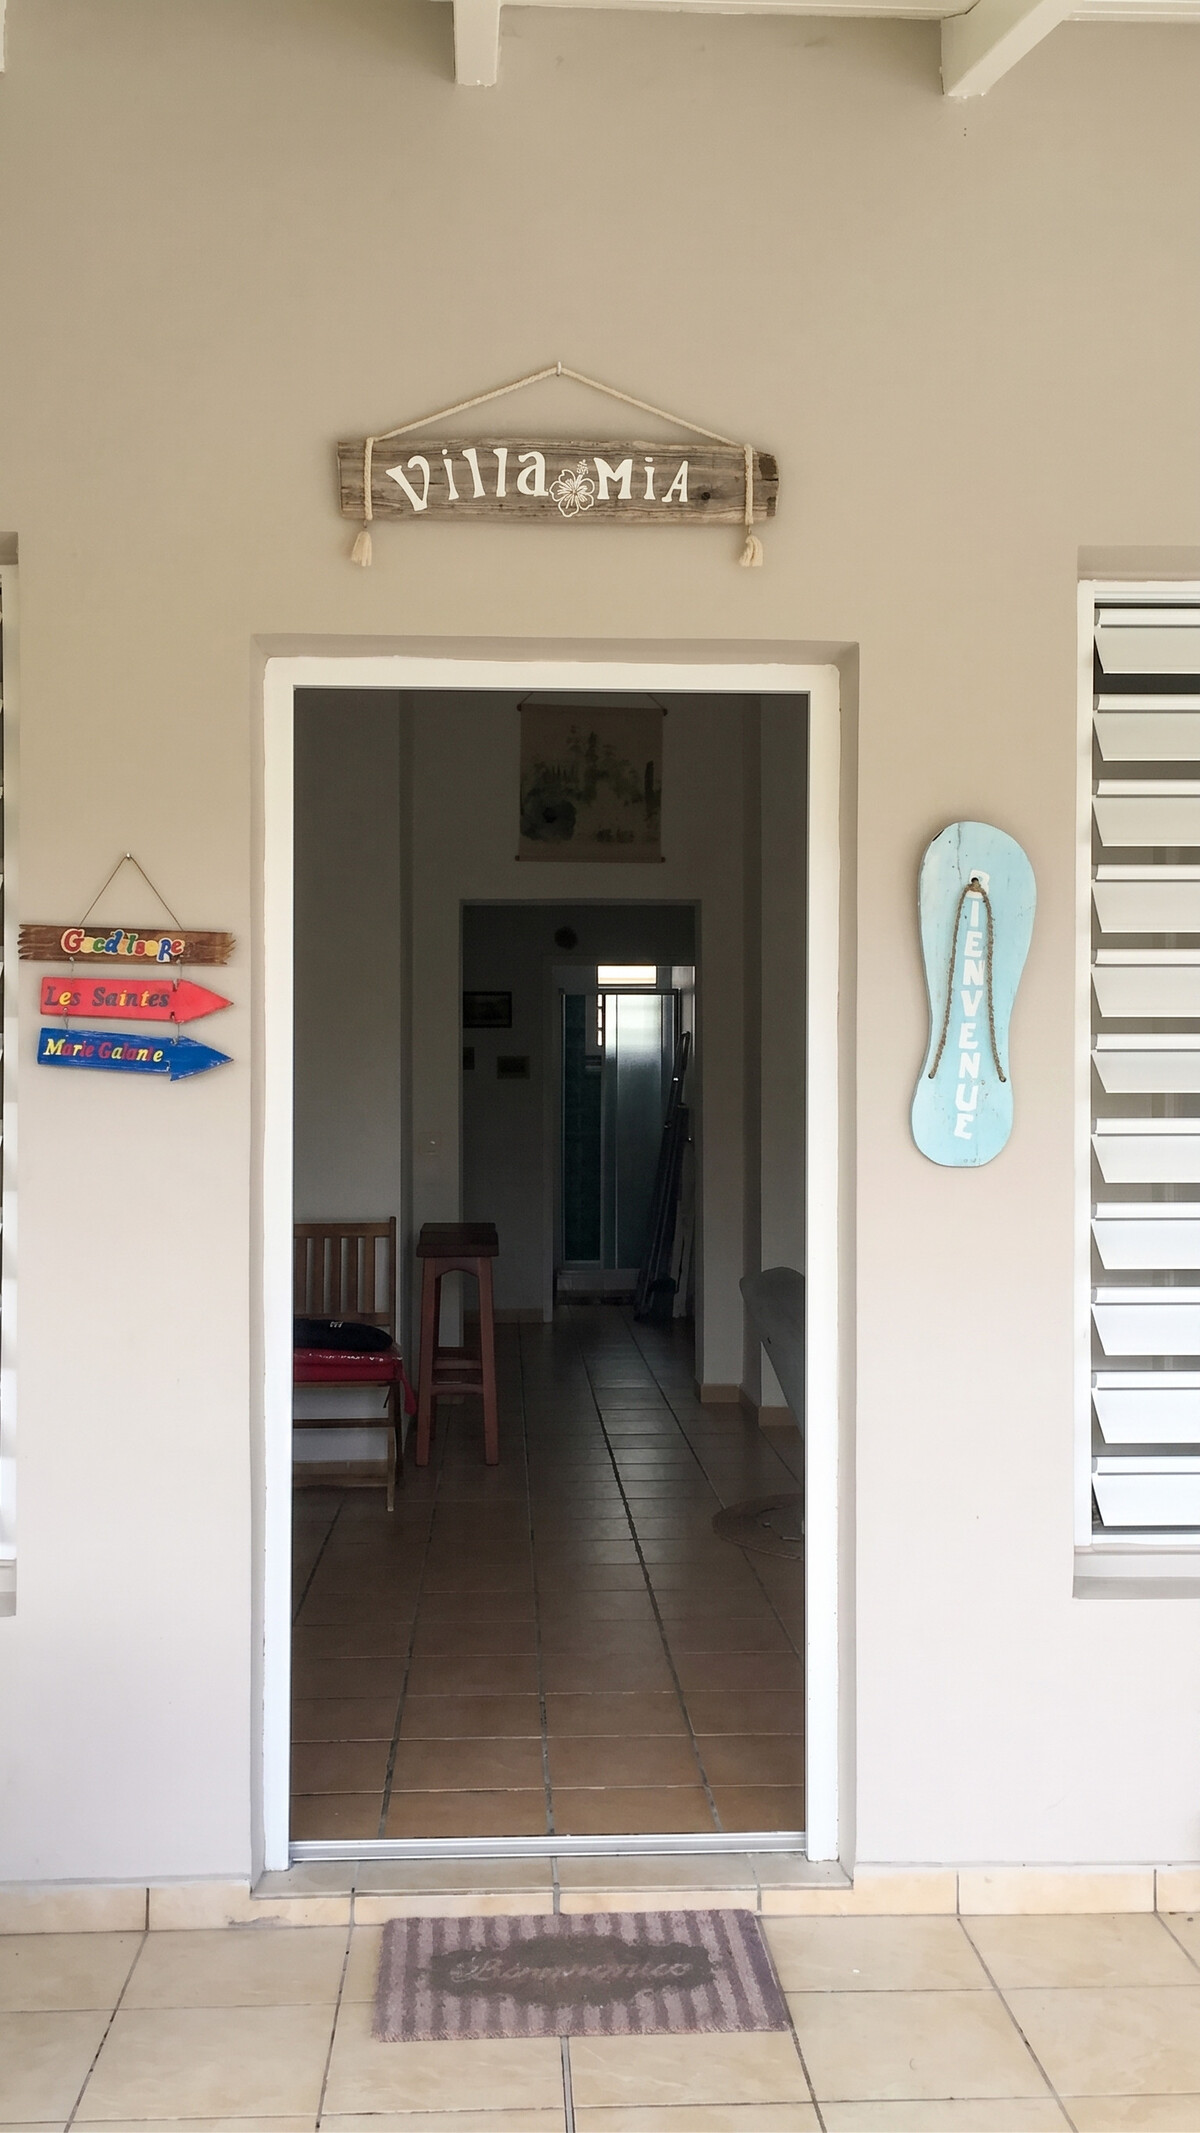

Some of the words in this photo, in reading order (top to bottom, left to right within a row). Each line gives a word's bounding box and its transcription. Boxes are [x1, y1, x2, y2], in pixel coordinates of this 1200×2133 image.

[385, 447, 549, 512] Villa
[44, 985, 81, 1006] Les
[92, 986, 170, 1007] Saintes
[953, 868, 990, 1140] BIENVENUE
[42, 1038, 95, 1058] Marie
